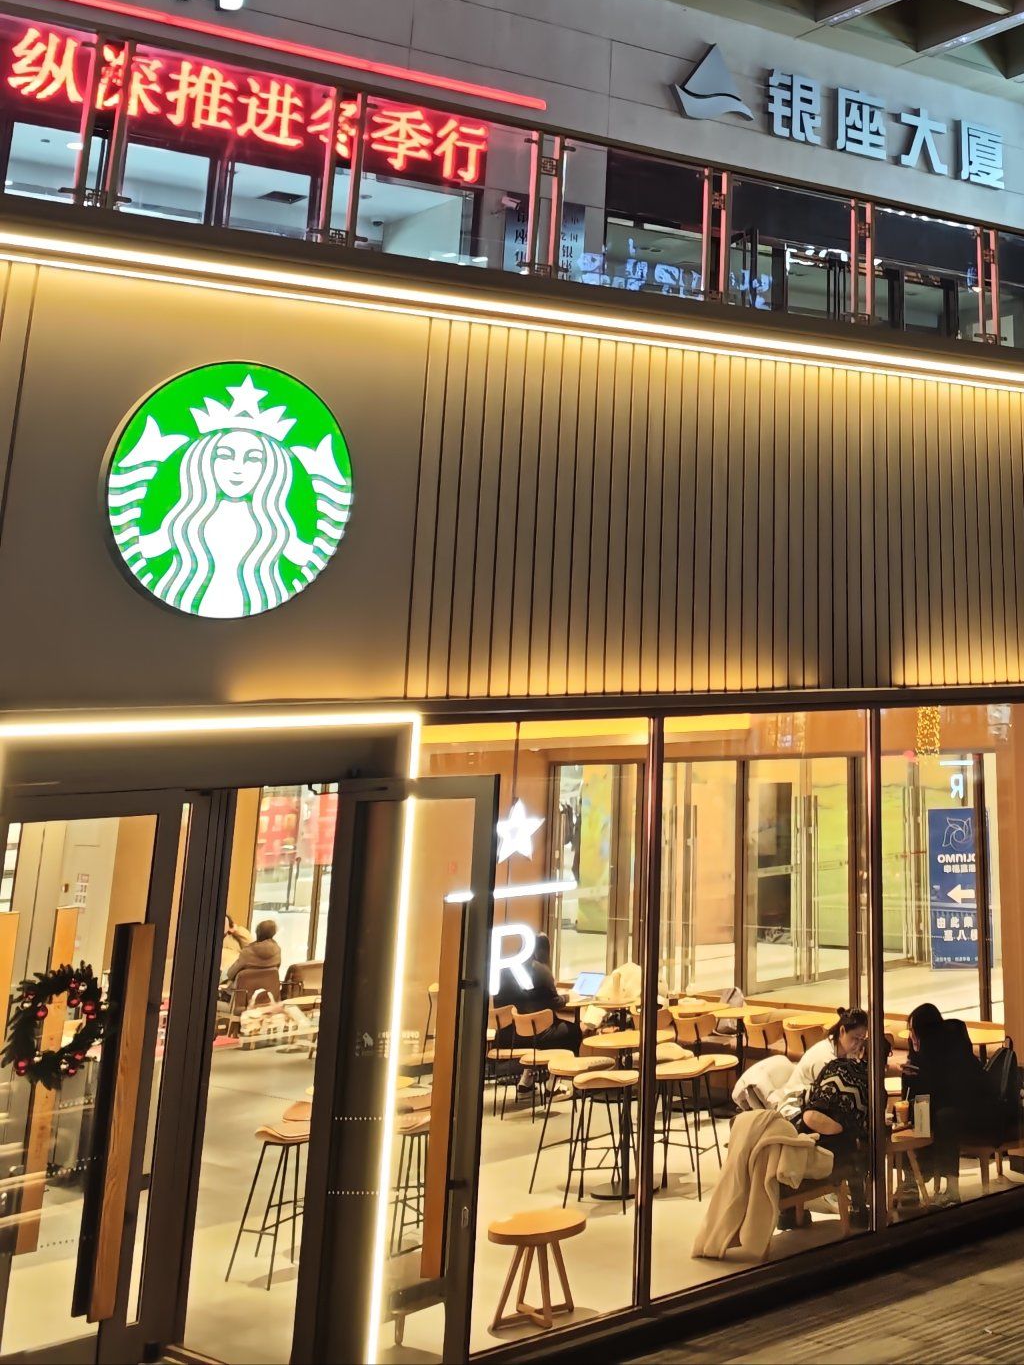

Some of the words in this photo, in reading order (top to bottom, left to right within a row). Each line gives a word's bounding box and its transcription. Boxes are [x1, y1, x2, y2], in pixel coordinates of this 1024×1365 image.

[767, 68, 1006, 190] 银座大厦
[488, 923, 536, 997] R
